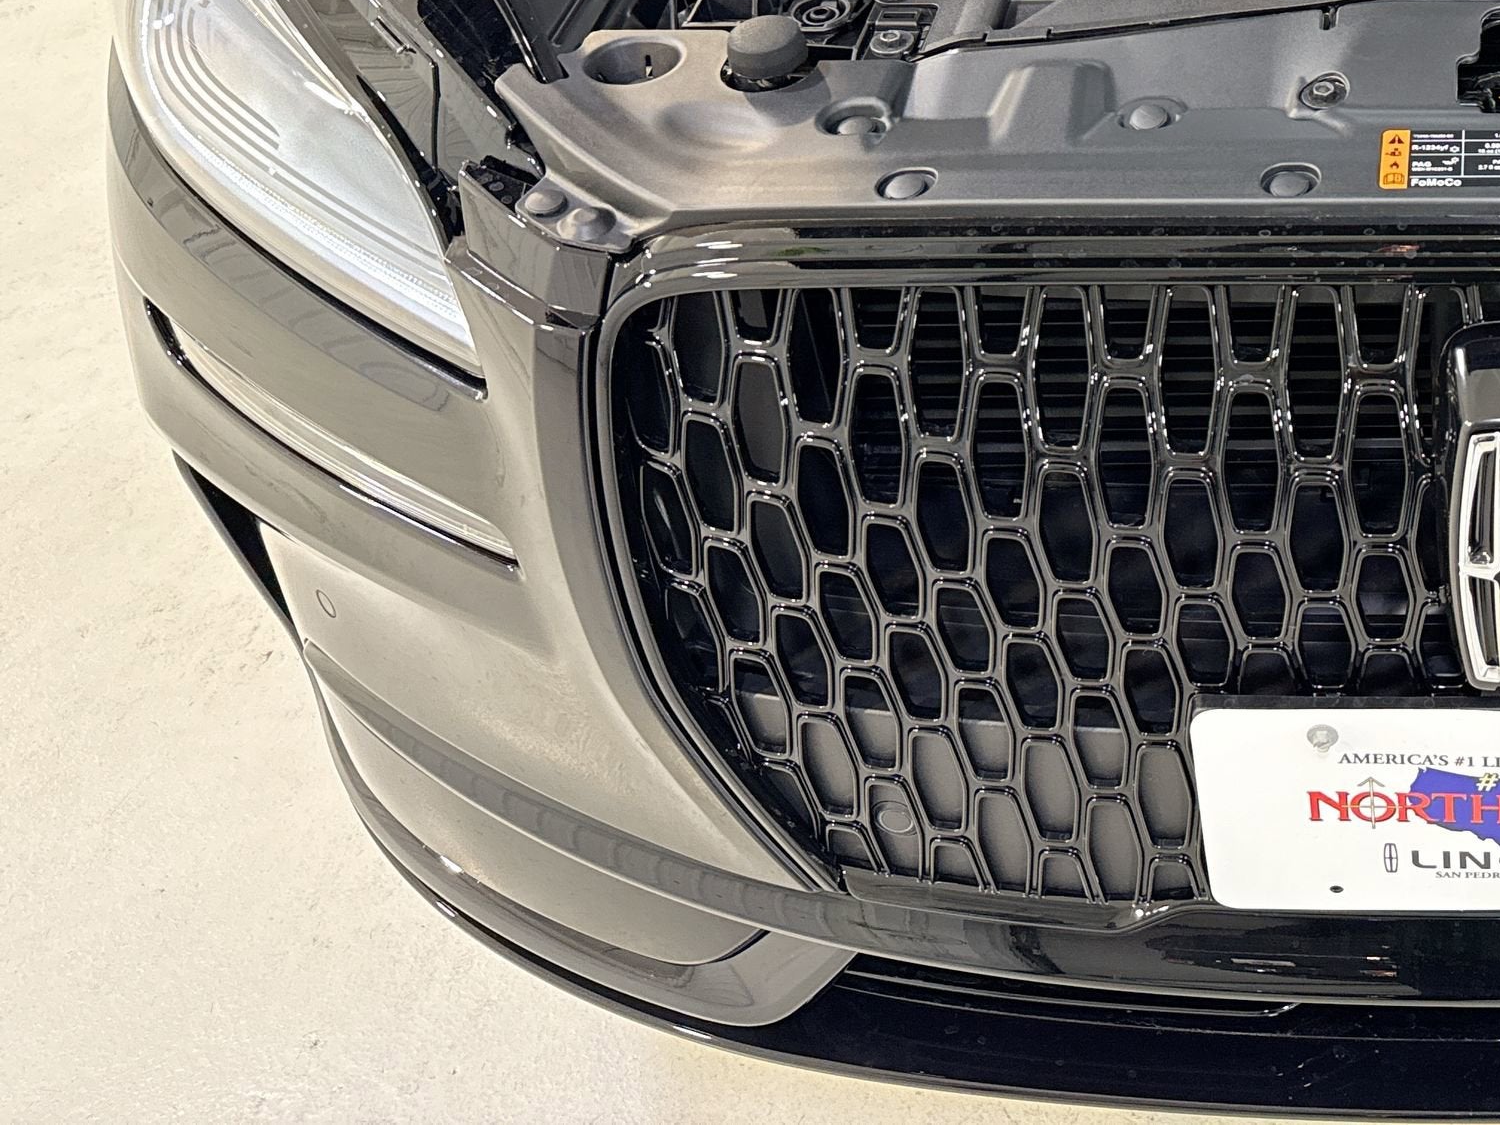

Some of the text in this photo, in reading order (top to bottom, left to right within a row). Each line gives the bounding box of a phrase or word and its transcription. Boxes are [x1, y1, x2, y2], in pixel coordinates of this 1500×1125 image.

[1411, 178, 1462, 187] FoMoCo
[1338, 753, 1449, 766] AMERICA'S
[1454, 756, 1474, 767] #1
[1435, 871, 1461, 879] SAN
